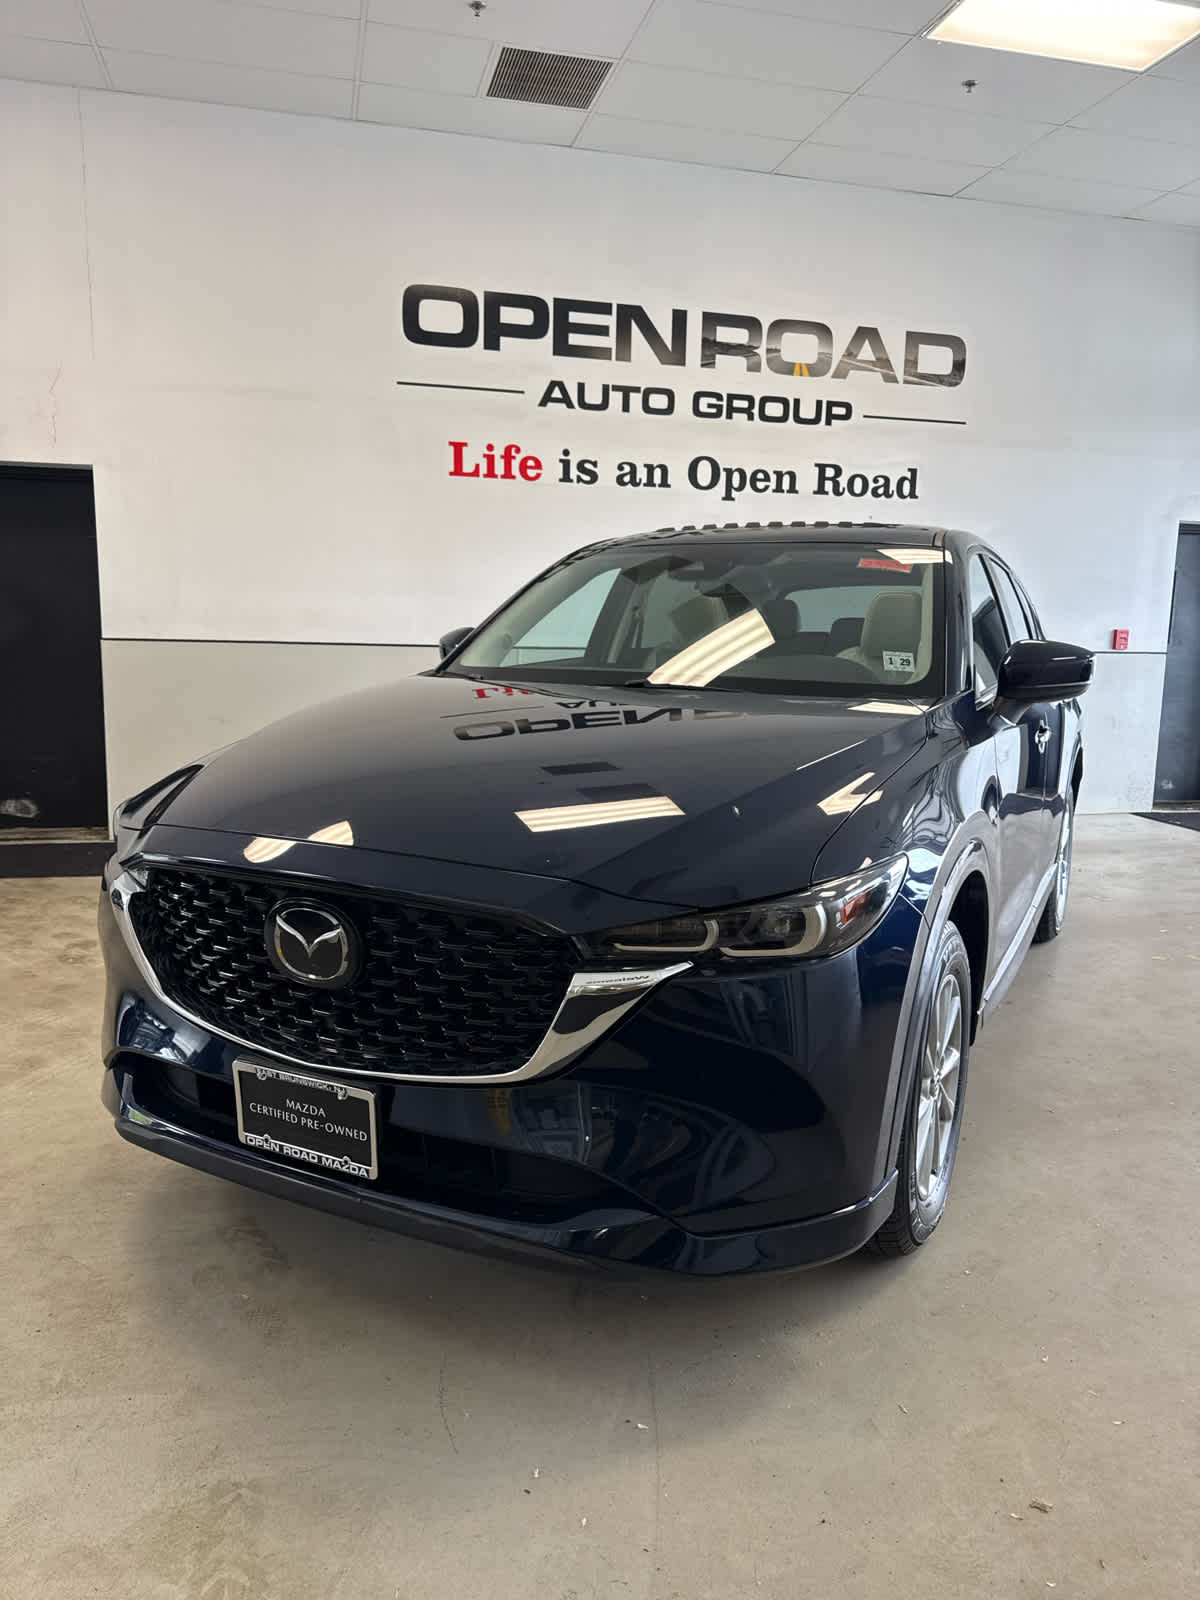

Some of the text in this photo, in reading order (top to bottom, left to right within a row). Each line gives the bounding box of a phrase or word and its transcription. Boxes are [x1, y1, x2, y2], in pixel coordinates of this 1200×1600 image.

[402, 283, 967, 389] OPEN ROAD
[538, 379, 853, 426] AUTO GROUP
[448, 441, 919, 502] Life is an Open Road
[900, 657, 911, 666] 29
[249, 1102, 368, 1142] CERTIFIED PRE-OWNED
[286, 1099, 327, 1118] MAZDA
[246, 1135, 369, 1178] OPEN ROAD MAZDA
